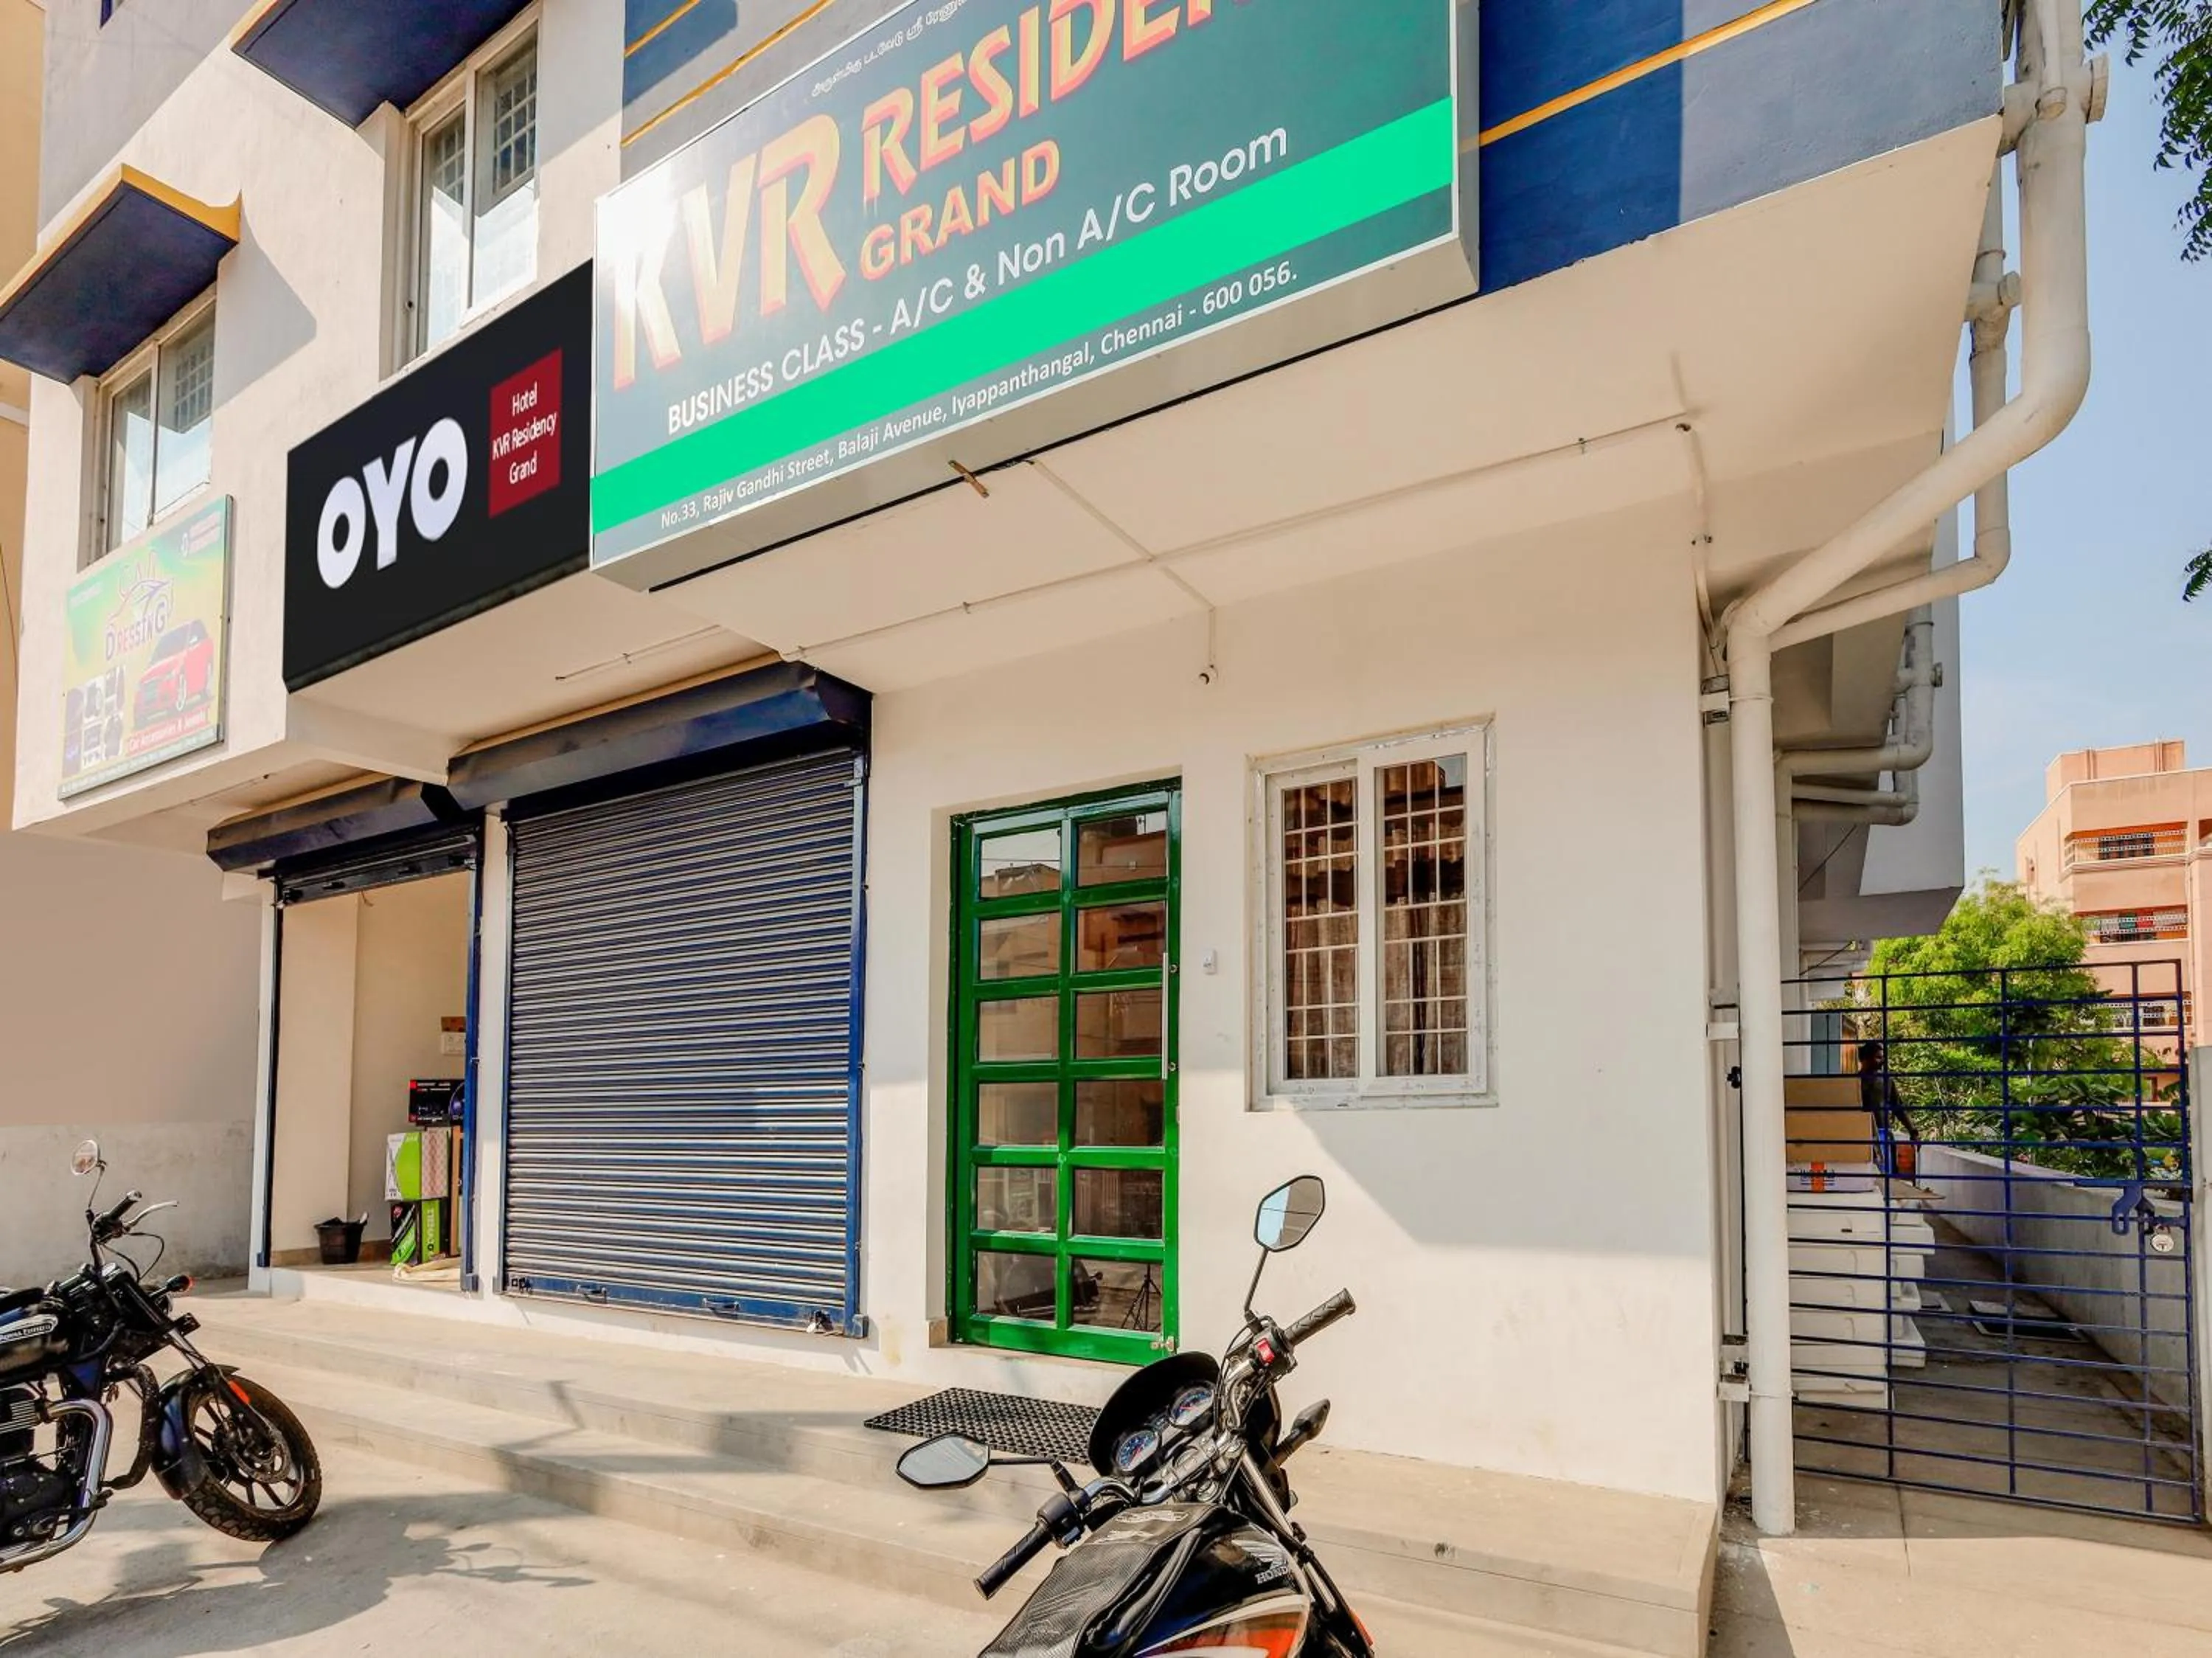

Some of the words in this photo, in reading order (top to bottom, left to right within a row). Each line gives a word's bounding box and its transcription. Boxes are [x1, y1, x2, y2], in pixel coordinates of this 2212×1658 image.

[613, 113, 846, 392] KVR
[860, 0, 1248, 204] RESIDE
[859, 139, 1060, 280] GRAND
[667, 360, 773, 435] BUSINESS
[781, 318, 865, 382] CLASS
[889, 278, 953, 338] A/C
[964, 265, 987, 299] &
[997, 232, 1065, 284] Non
[1077, 182, 1156, 250] A/C
[1169, 126, 1287, 207] Room
[492, 432, 511, 461] KVR
[512, 411, 557, 451] Residency
[512, 381, 538, 417] Hotel
[661, 500, 700, 530] No.33,
[703, 481, 734, 515] Rajiv
[737, 463, 785, 499] Gandhi
[787, 448, 834, 480] Street,
[838, 427, 880, 459] Balaji
[883, 406, 949, 443] Avenue,
[952, 341, 1096, 416] Iyappanthangal,
[1100, 303, 1183, 355] Chennai
[1203, 280, 1242, 316] 600
[1248, 260, 1298, 296] 056.
[316, 417, 468, 589] OYO
[509, 449, 538, 485] Grand
[1254, 1566, 1289, 1585] HOND
